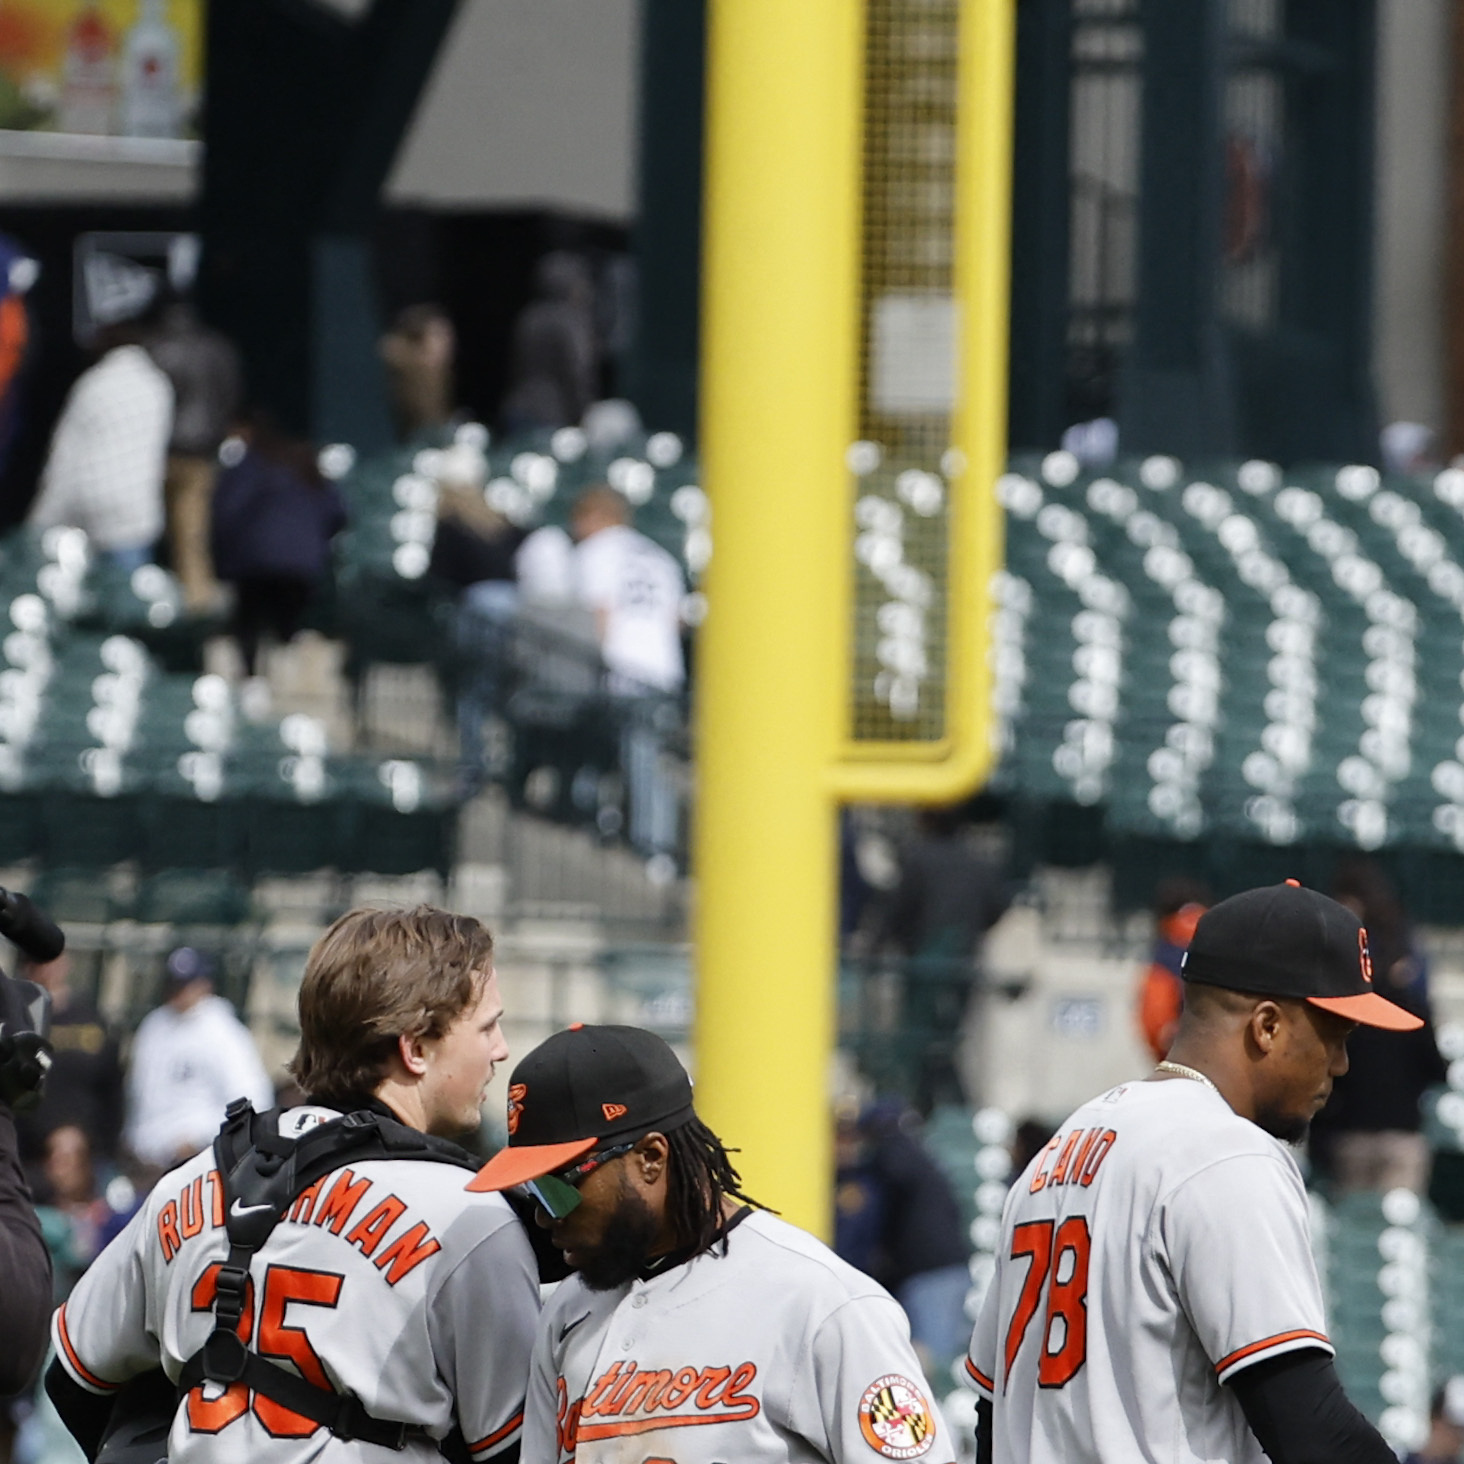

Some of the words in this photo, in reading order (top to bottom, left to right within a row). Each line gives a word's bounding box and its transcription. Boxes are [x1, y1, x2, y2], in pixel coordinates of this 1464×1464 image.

[157, 1168, 442, 1288] RUTHMAN
[1029, 1129, 1117, 1195] CANO
[186, 1260, 345, 1440] 35
[1003, 1215, 1091, 1397] 78
